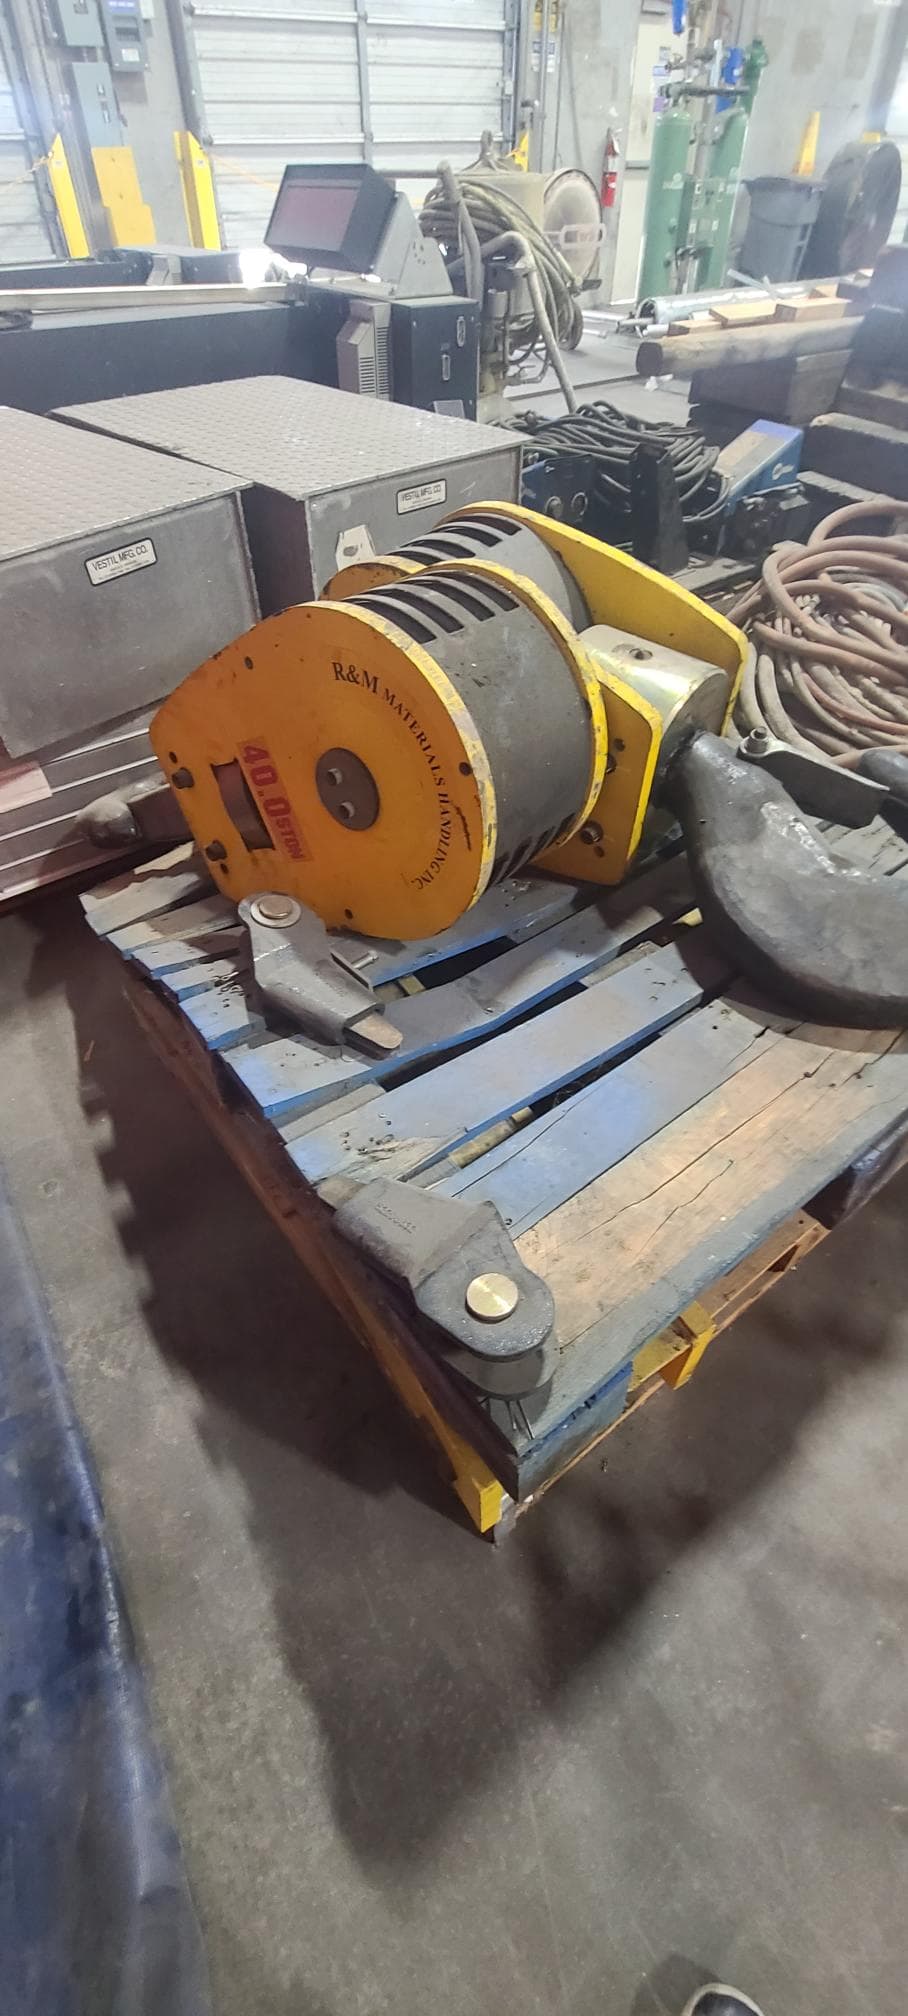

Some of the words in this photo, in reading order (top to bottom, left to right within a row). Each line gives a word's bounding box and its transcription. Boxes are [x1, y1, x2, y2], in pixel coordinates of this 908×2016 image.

[92, 556, 119, 571] VESTIL
[332, 662, 380, 694] R&M
[383, 688, 446, 787] MATERIALS
[430, 793, 451, 875] HANDLING
[410, 869, 434, 889] INC.
